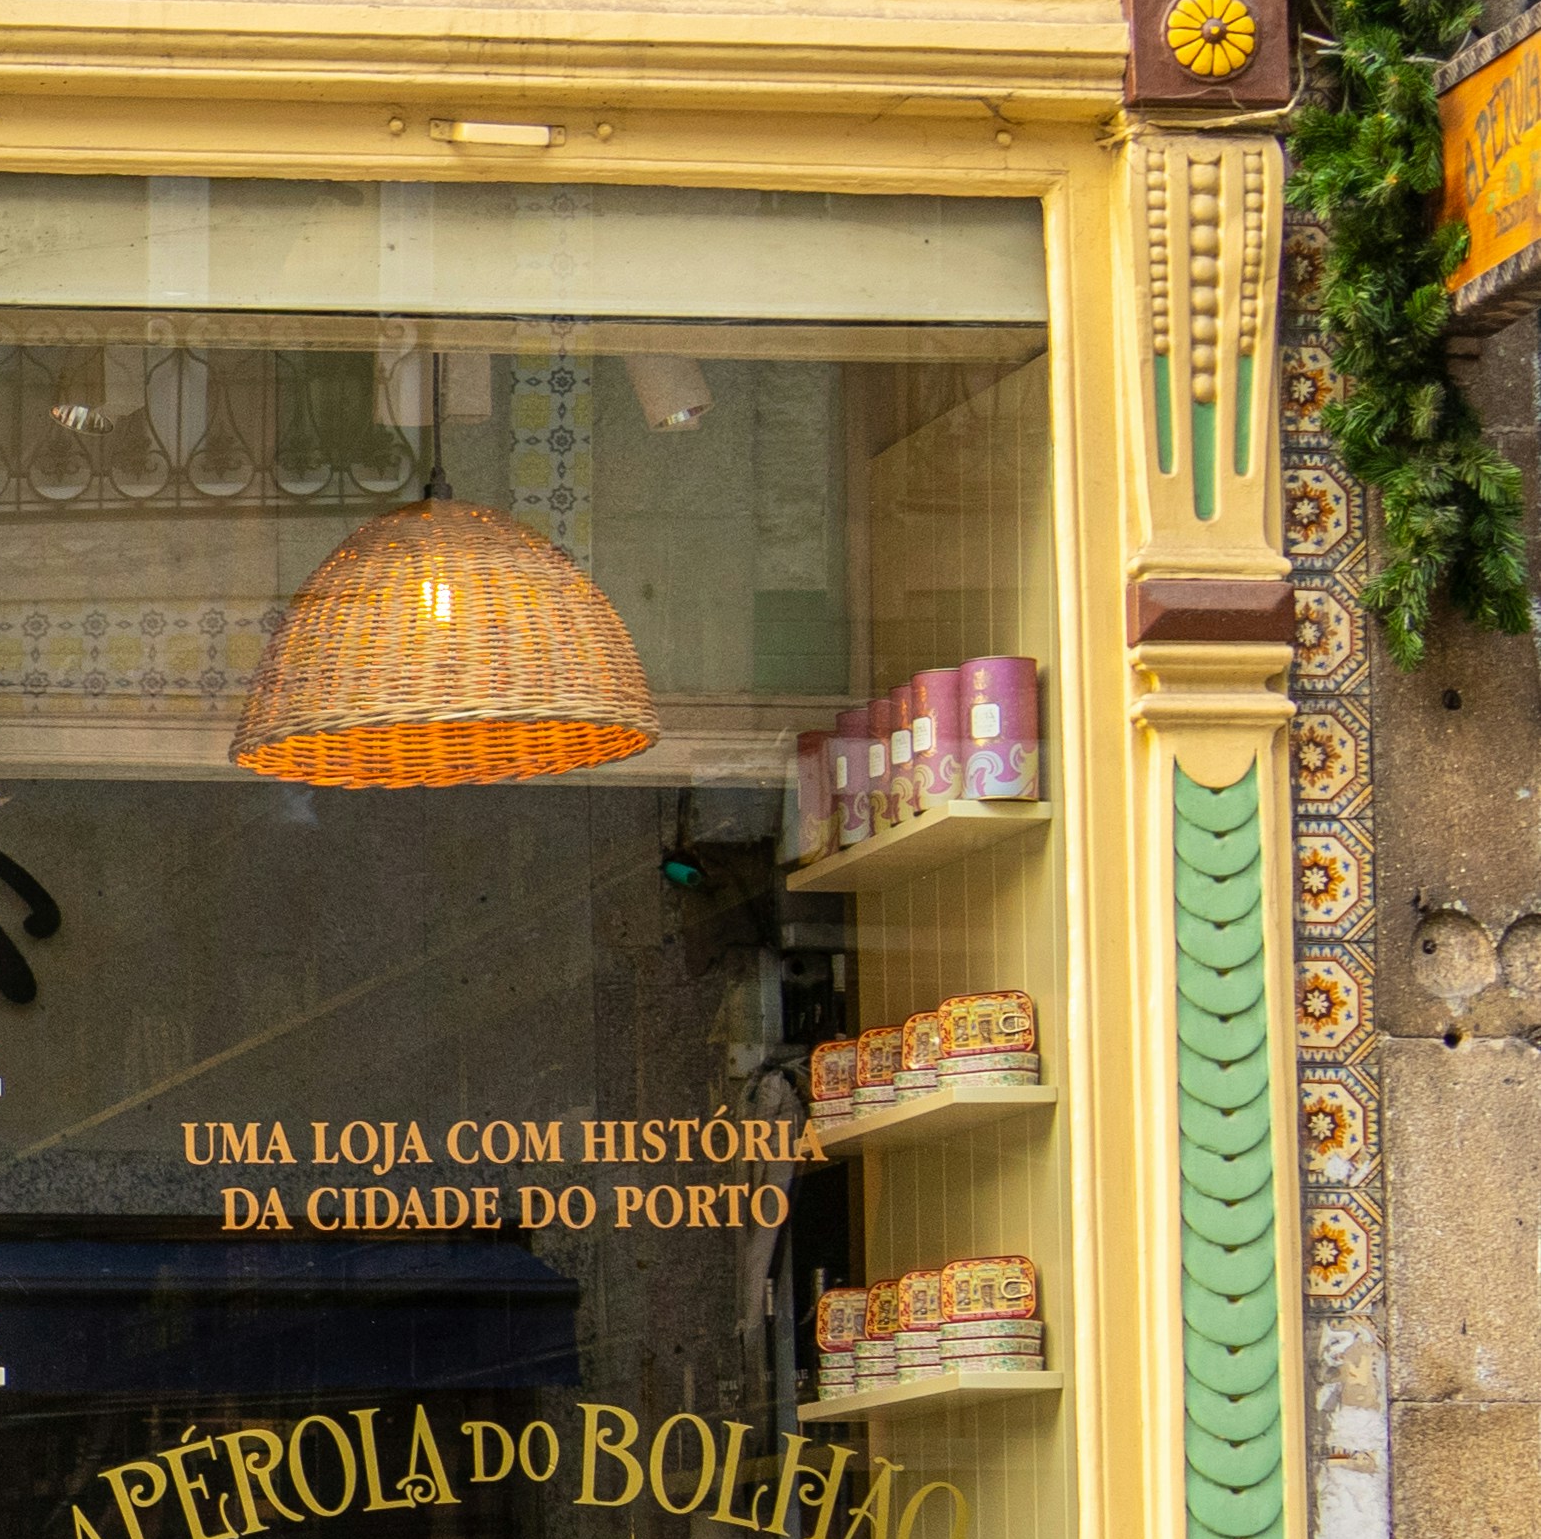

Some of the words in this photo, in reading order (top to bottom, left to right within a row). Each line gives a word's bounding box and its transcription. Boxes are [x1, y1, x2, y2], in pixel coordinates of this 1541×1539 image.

[181, 1122, 298, 1165] UMA
[310, 1121, 434, 1175] LOJA
[446, 1120, 564, 1165] COM
[580, 1105, 829, 1164] HISTÓRIA
[220, 1187, 293, 1232] DA
[306, 1186, 502, 1231] CIDADE
[517, 1186, 597, 1230] DO
[613, 1183, 790, 1230] PORTO
[460, 1420, 560, 1484] DO
